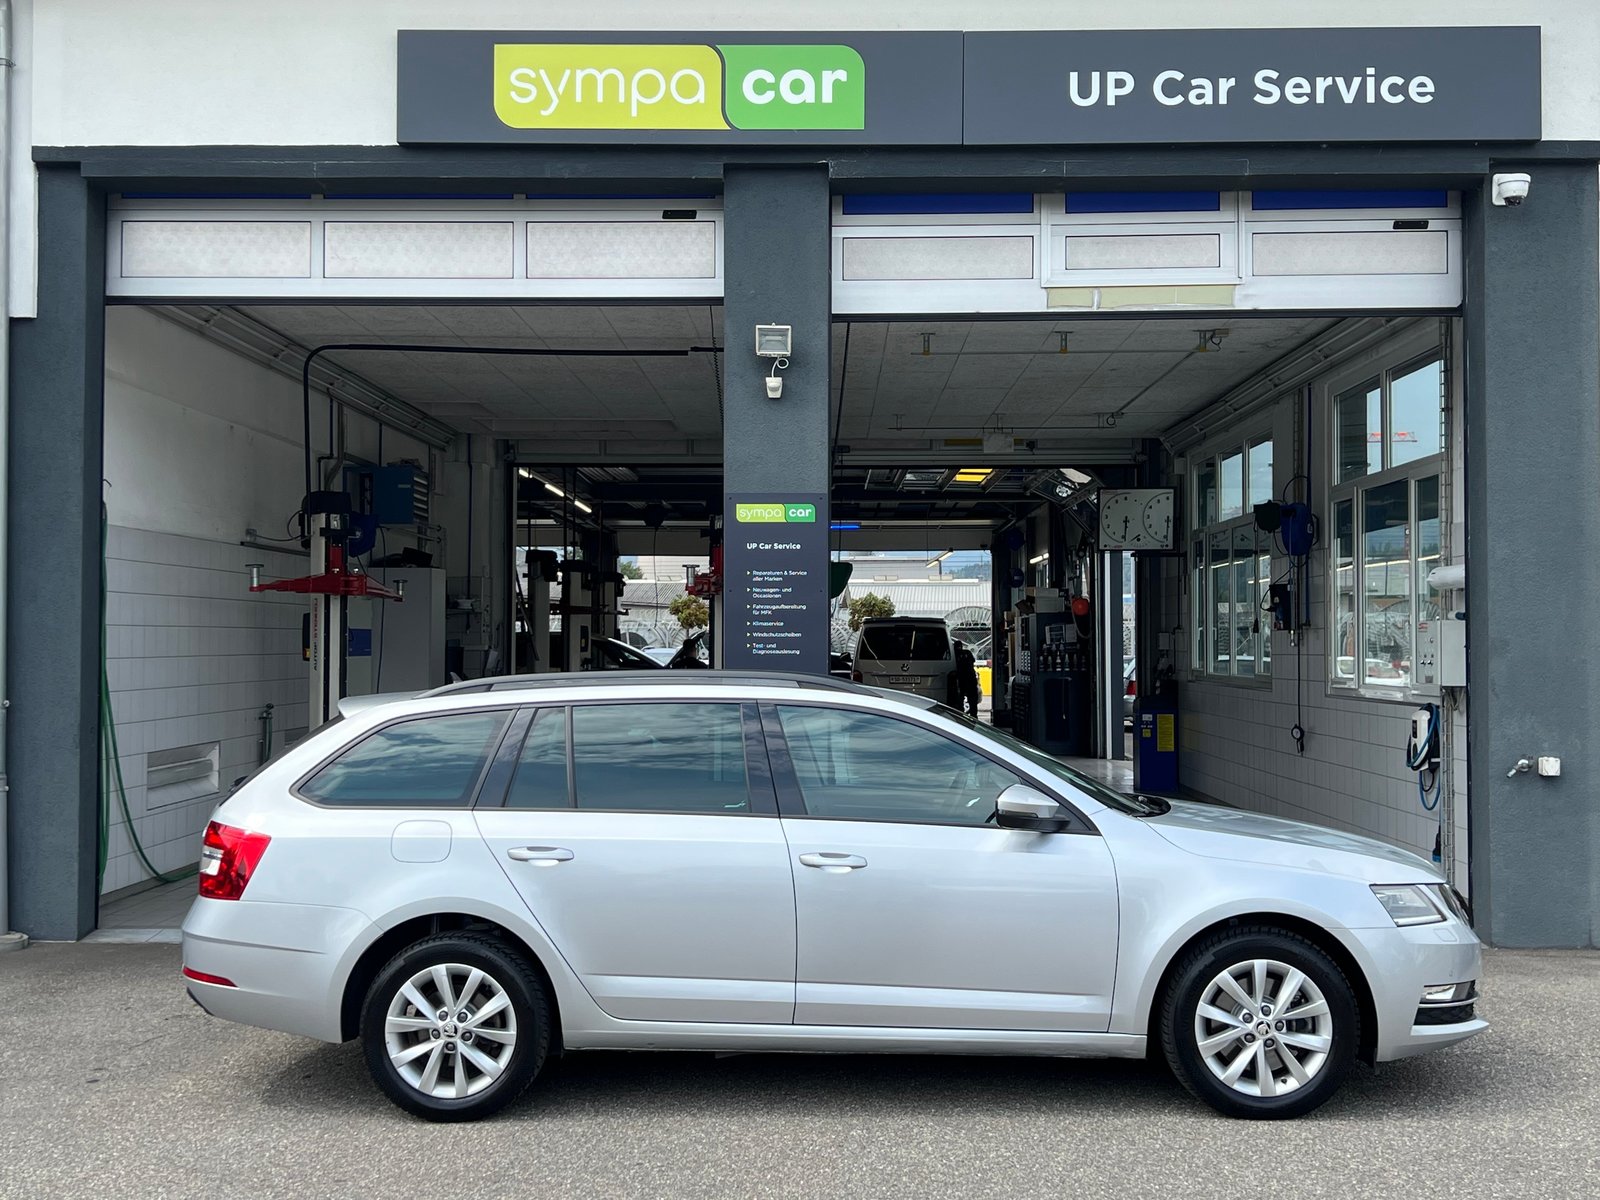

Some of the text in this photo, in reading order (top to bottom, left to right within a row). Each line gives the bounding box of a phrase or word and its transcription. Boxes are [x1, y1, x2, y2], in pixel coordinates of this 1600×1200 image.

[508, 67, 848, 117] sympa car
[1069, 67, 1436, 107] UP Car Service
[739, 507, 812, 520] sympa car
[746, 542, 802, 550] UP Car Service
